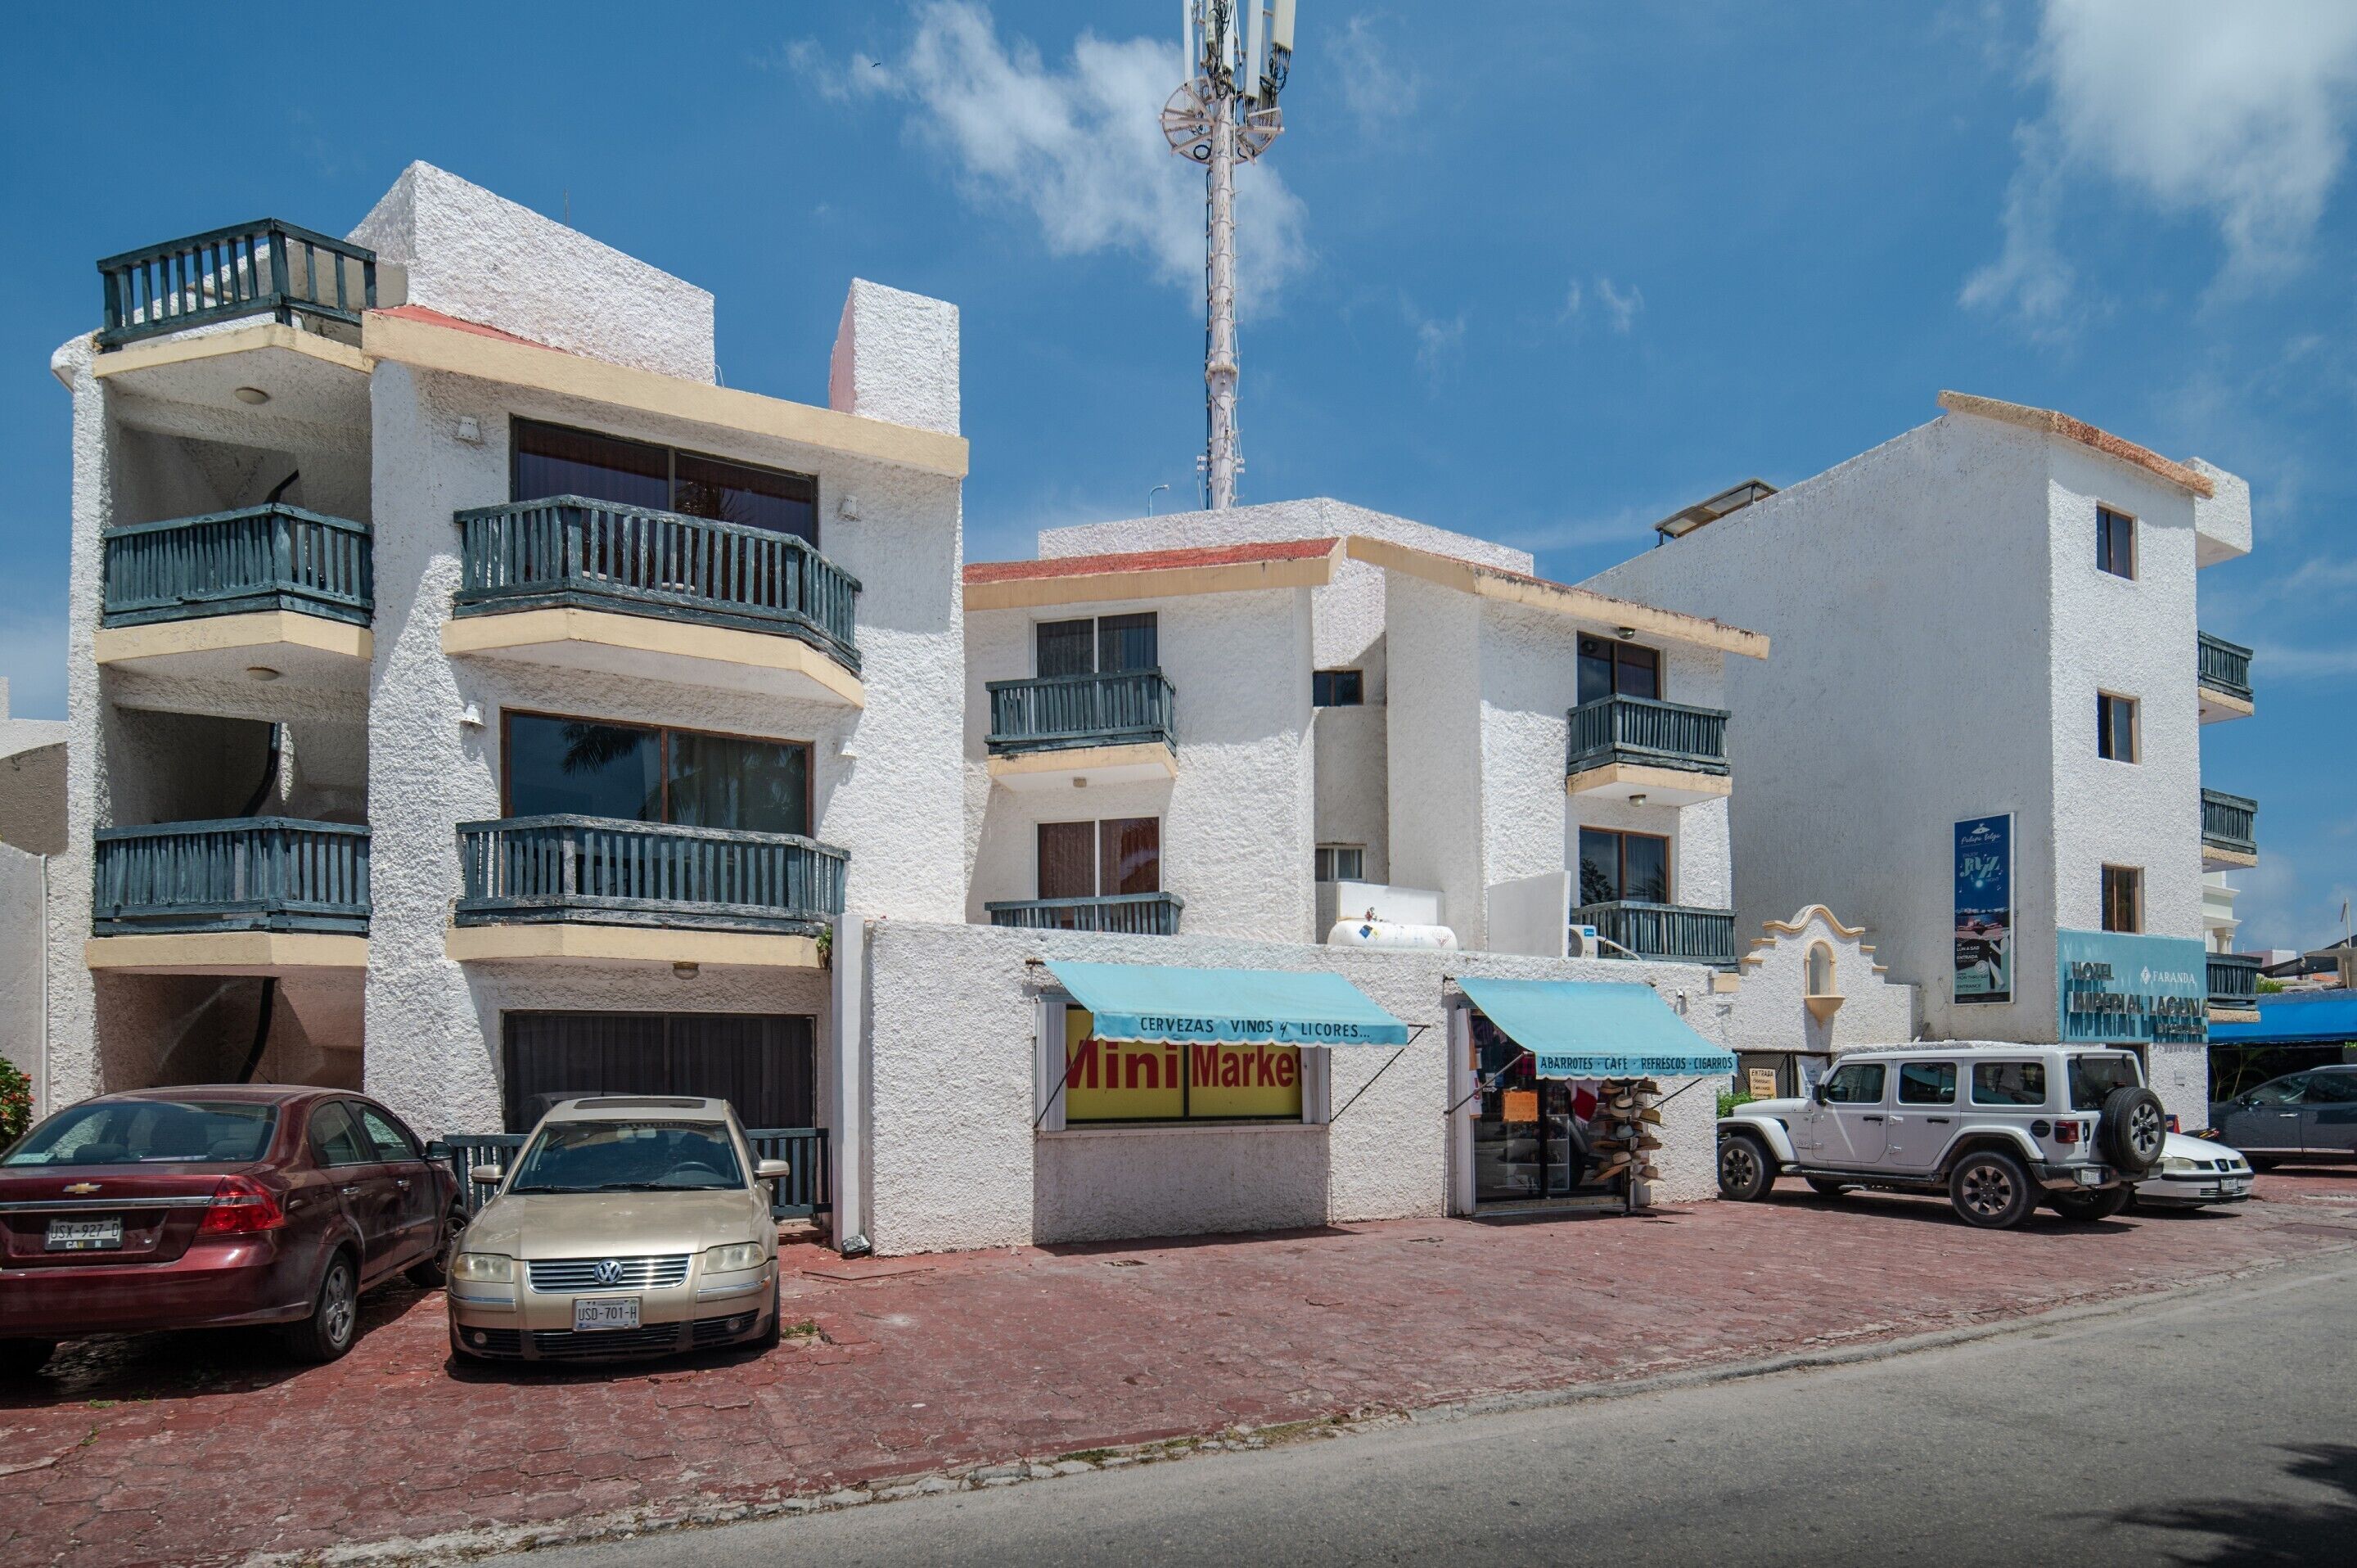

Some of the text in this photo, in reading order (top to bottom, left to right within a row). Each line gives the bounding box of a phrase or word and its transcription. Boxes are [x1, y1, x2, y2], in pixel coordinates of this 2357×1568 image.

[2071, 962, 2115, 980] HOTEL
[2153, 971, 2196, 984] FARANDA
[2070, 991, 2143, 1014] IMPERIAL
[1140, 1017, 1214, 1033] CERVEZAS
[1230, 1020, 1273, 1033] VINOS
[1066, 1039, 1178, 1089] Mini
[1540, 1057, 1593, 1070] ABARROTES
[1641, 1057, 1687, 1070] REFRESCOS
[1693, 1057, 1733, 1070] CIGARROS
[1751, 1070, 1773, 1078] ENTRADA
[50, 1223, 119, 1239] USX-927-D
[578, 1306, 637, 1321] USD-701-H
